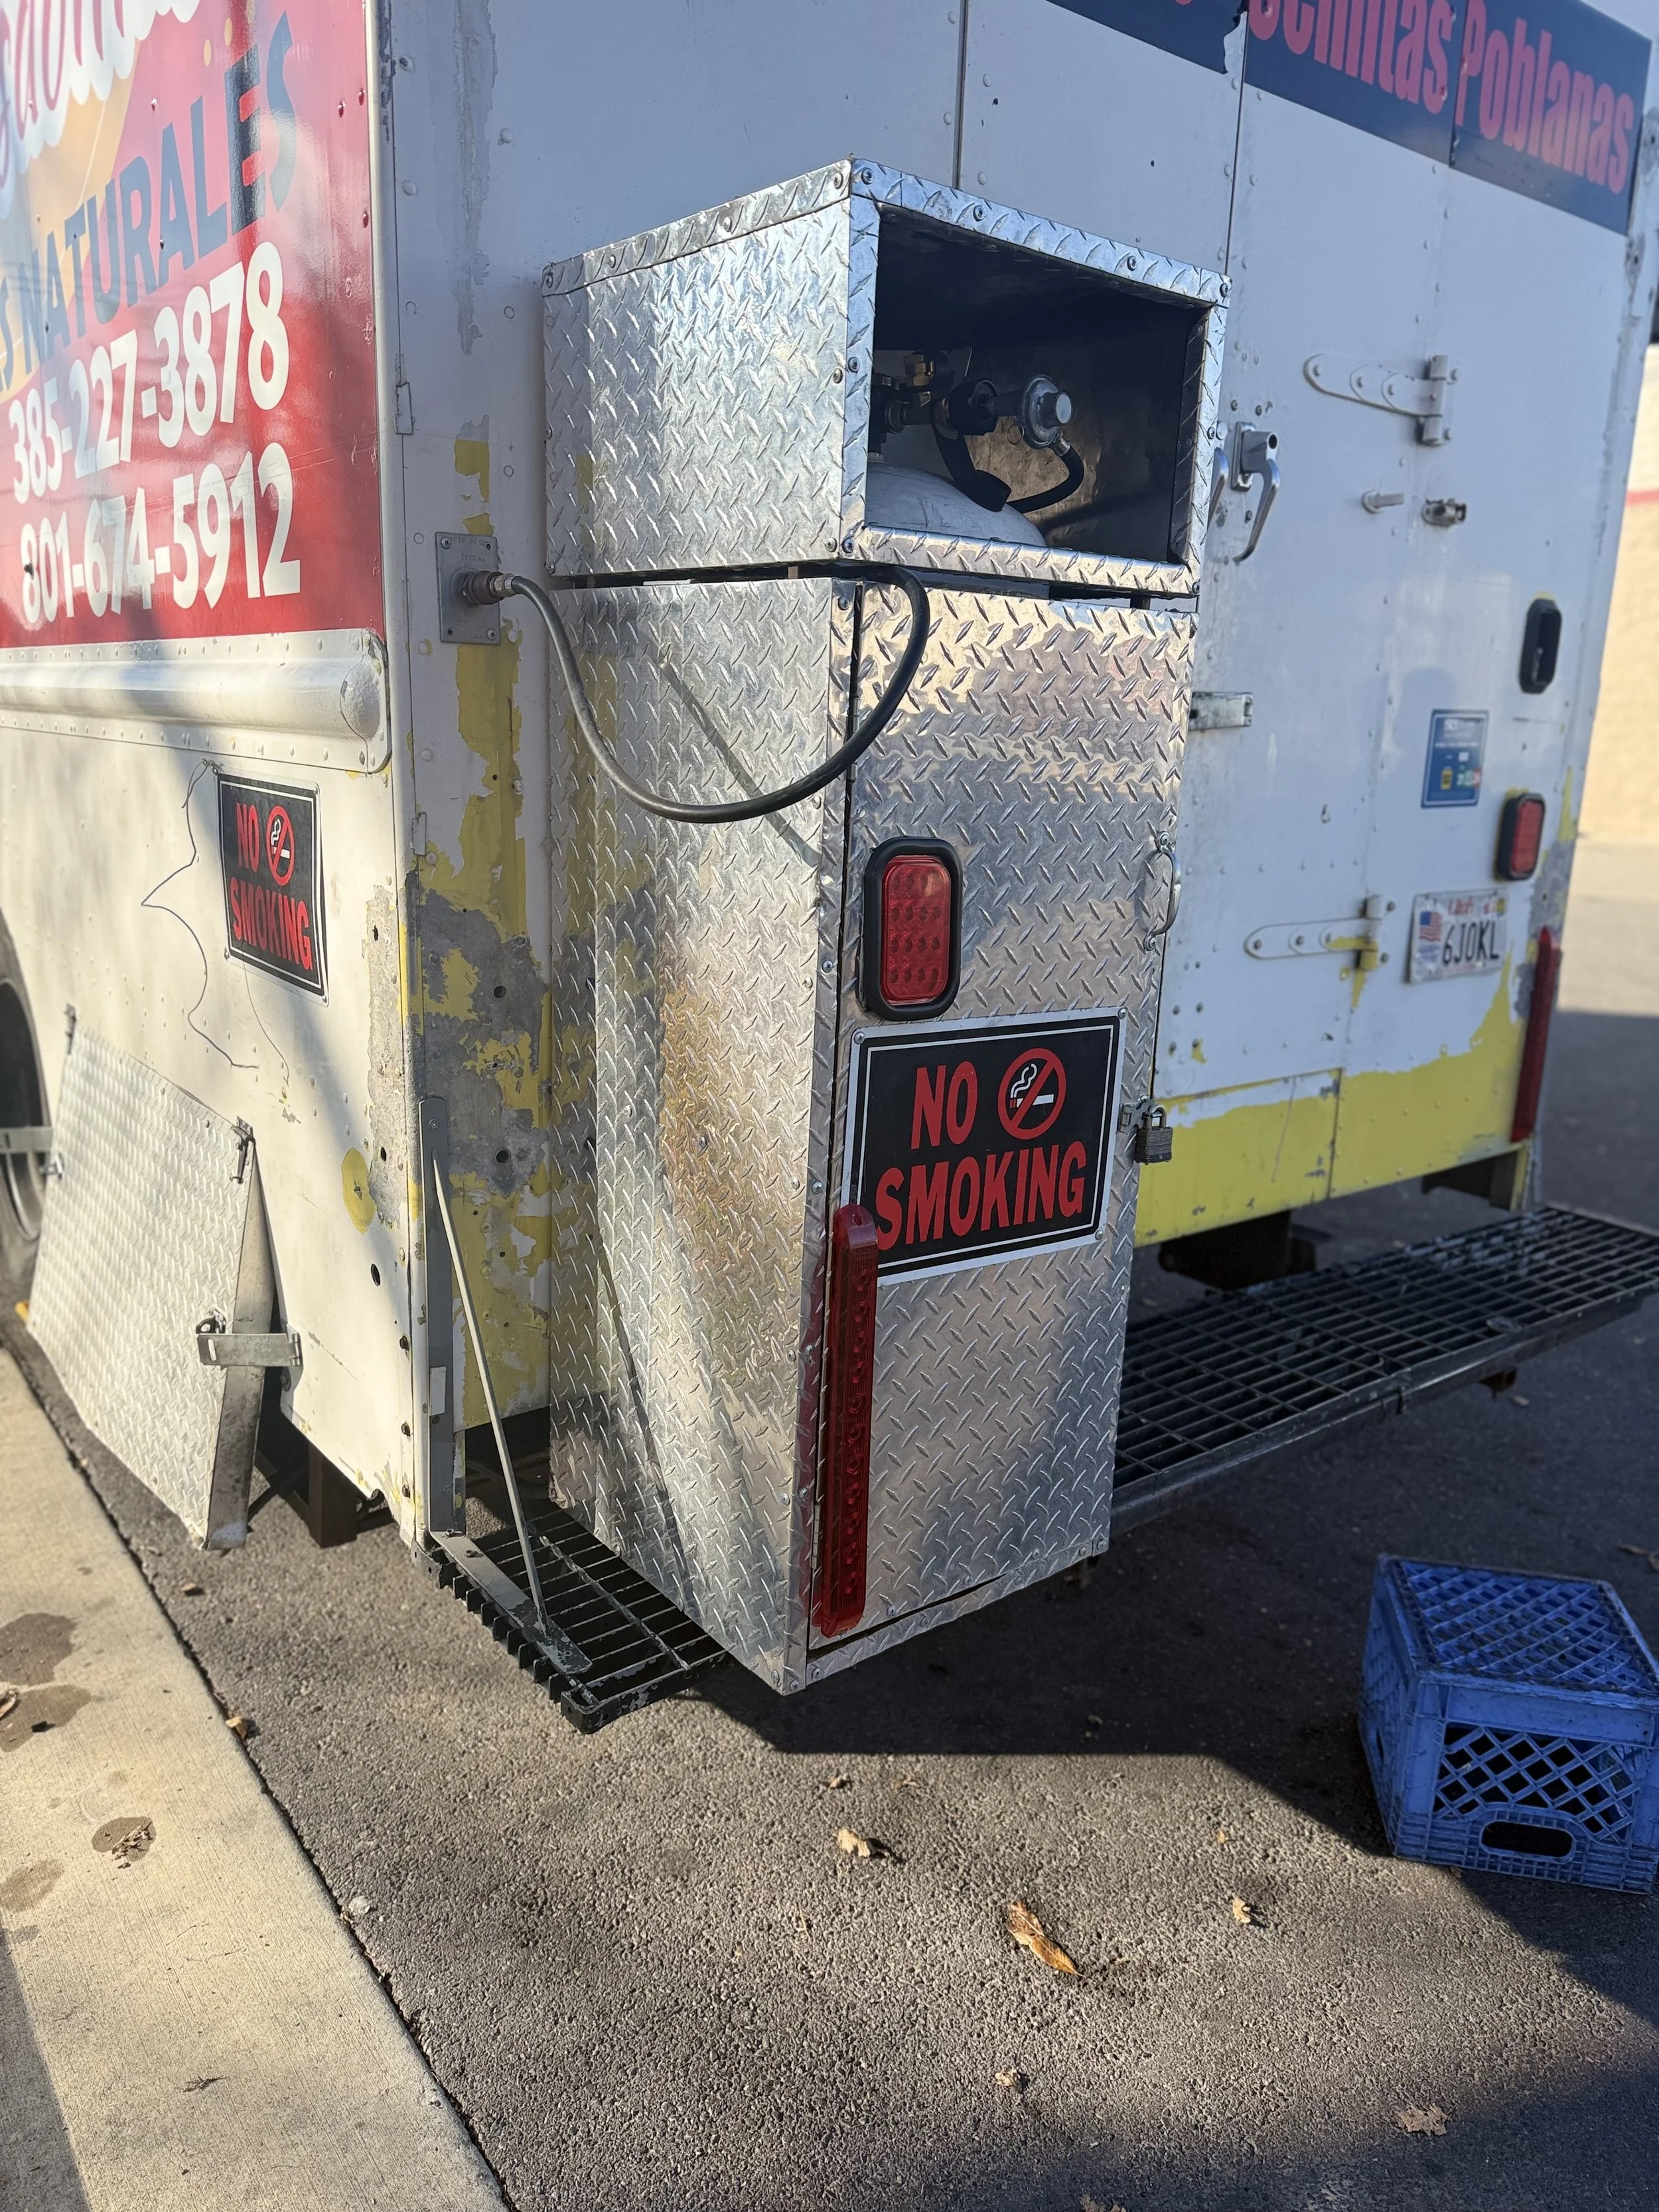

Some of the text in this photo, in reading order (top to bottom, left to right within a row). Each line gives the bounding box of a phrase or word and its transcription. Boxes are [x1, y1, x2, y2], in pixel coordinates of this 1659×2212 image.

[1455, 0, 1634, 194] Poblanas
[18, 10, 297, 376] NATURALES
[9, 241, 290, 504] 385-227-3878
[21, 441, 301, 624] 801-674-5912
[236, 802, 259, 872] NO
[230, 877, 313, 970] SMOKING
[910, 1061, 978, 1150] NO
[875, 1140, 1087, 1250] SMOKING
